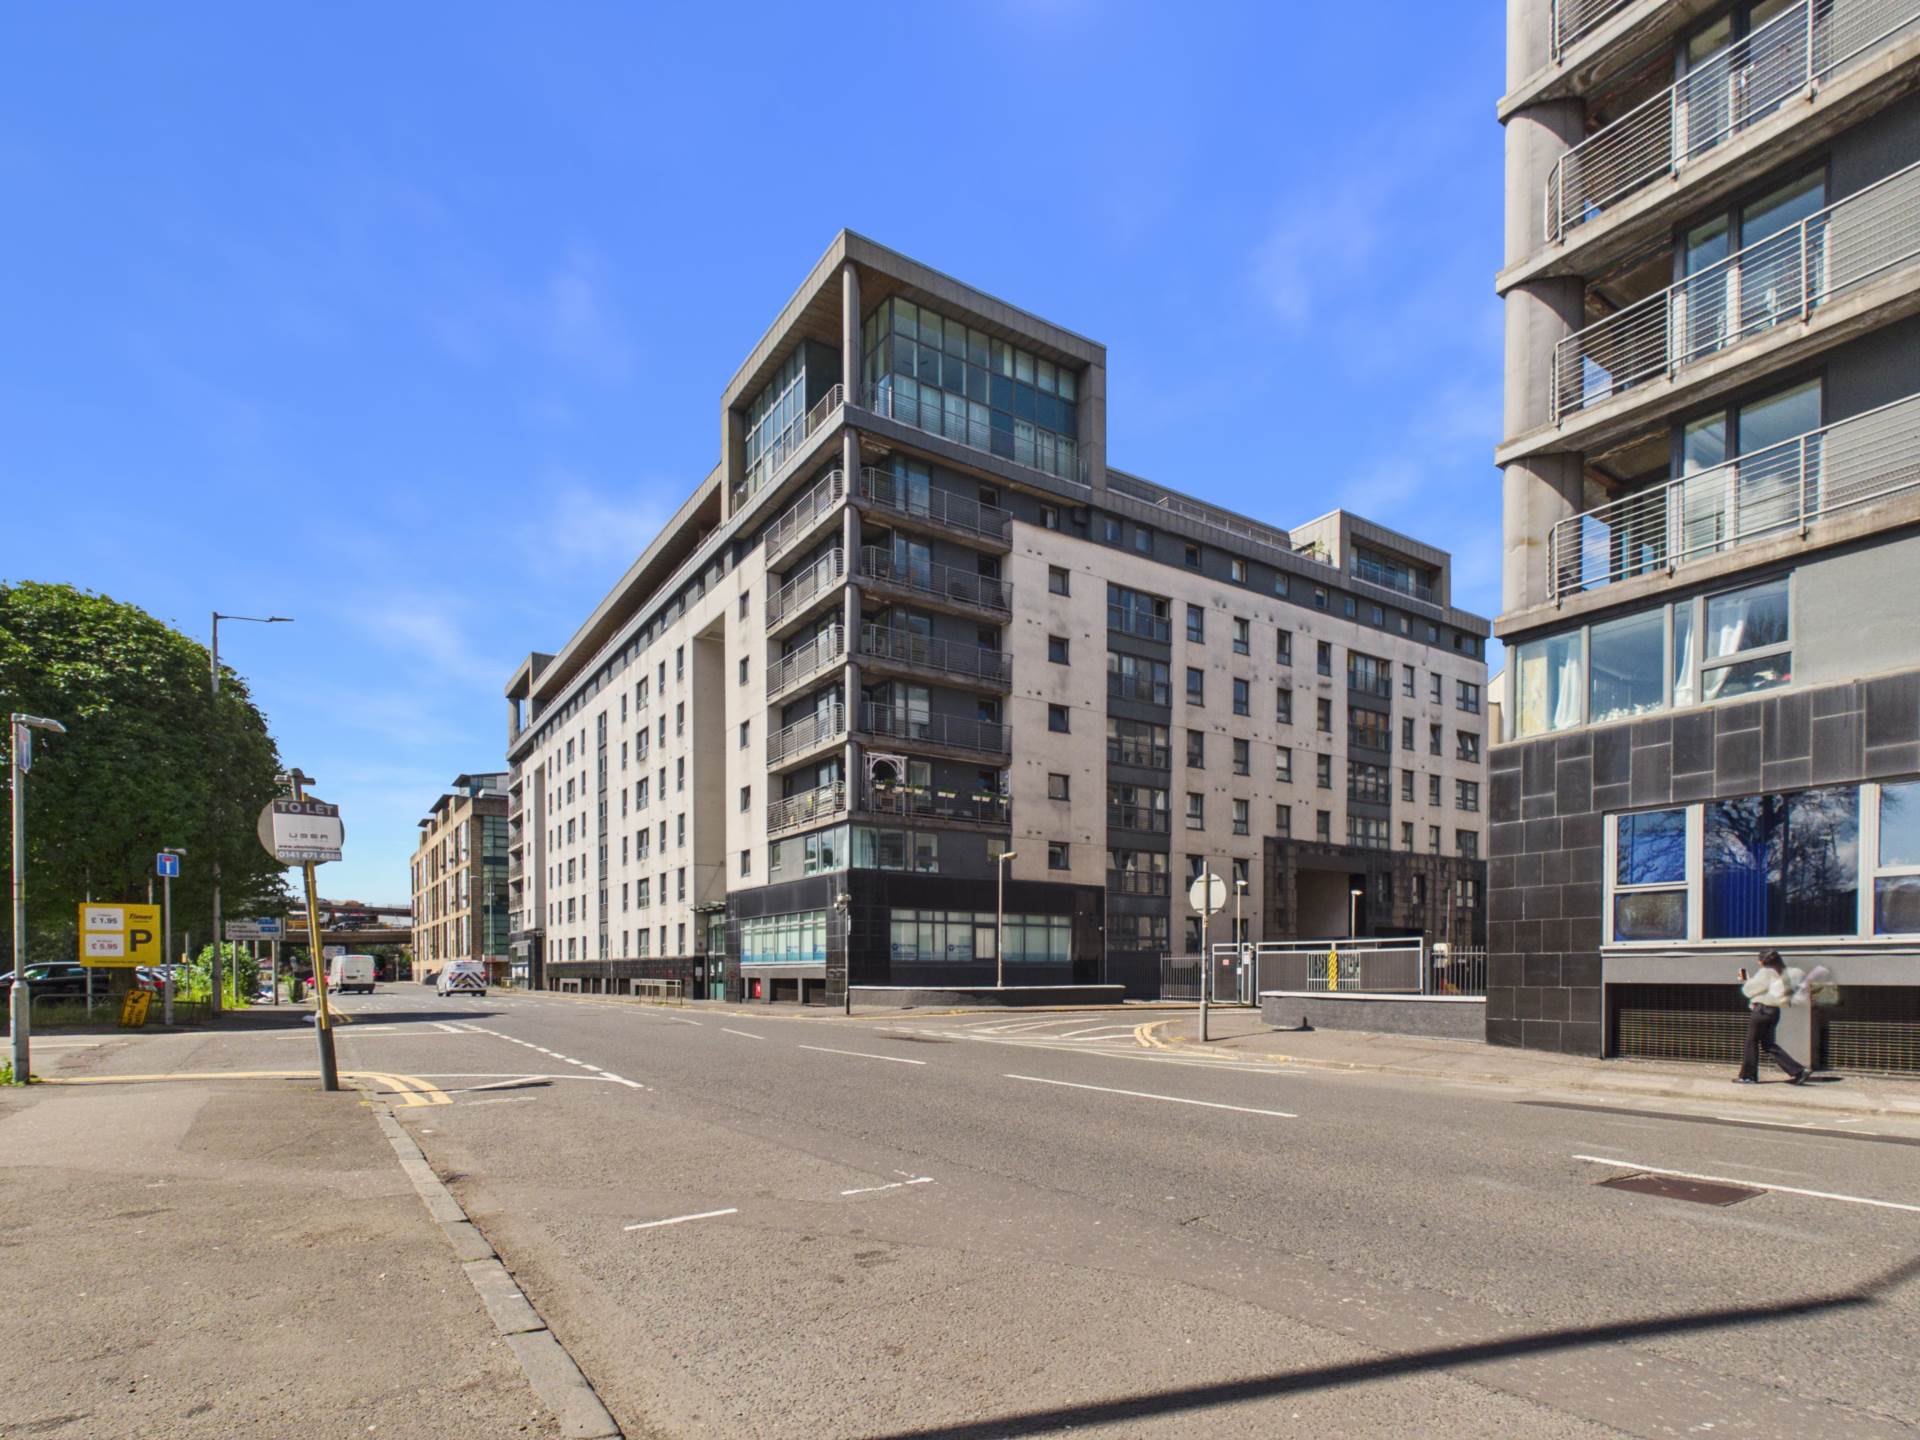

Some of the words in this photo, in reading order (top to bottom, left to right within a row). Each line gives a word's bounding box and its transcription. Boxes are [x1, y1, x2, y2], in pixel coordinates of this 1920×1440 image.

[278, 801, 301, 813] TO
[306, 803, 334, 815] LET
[130, 929, 153, 952] P
